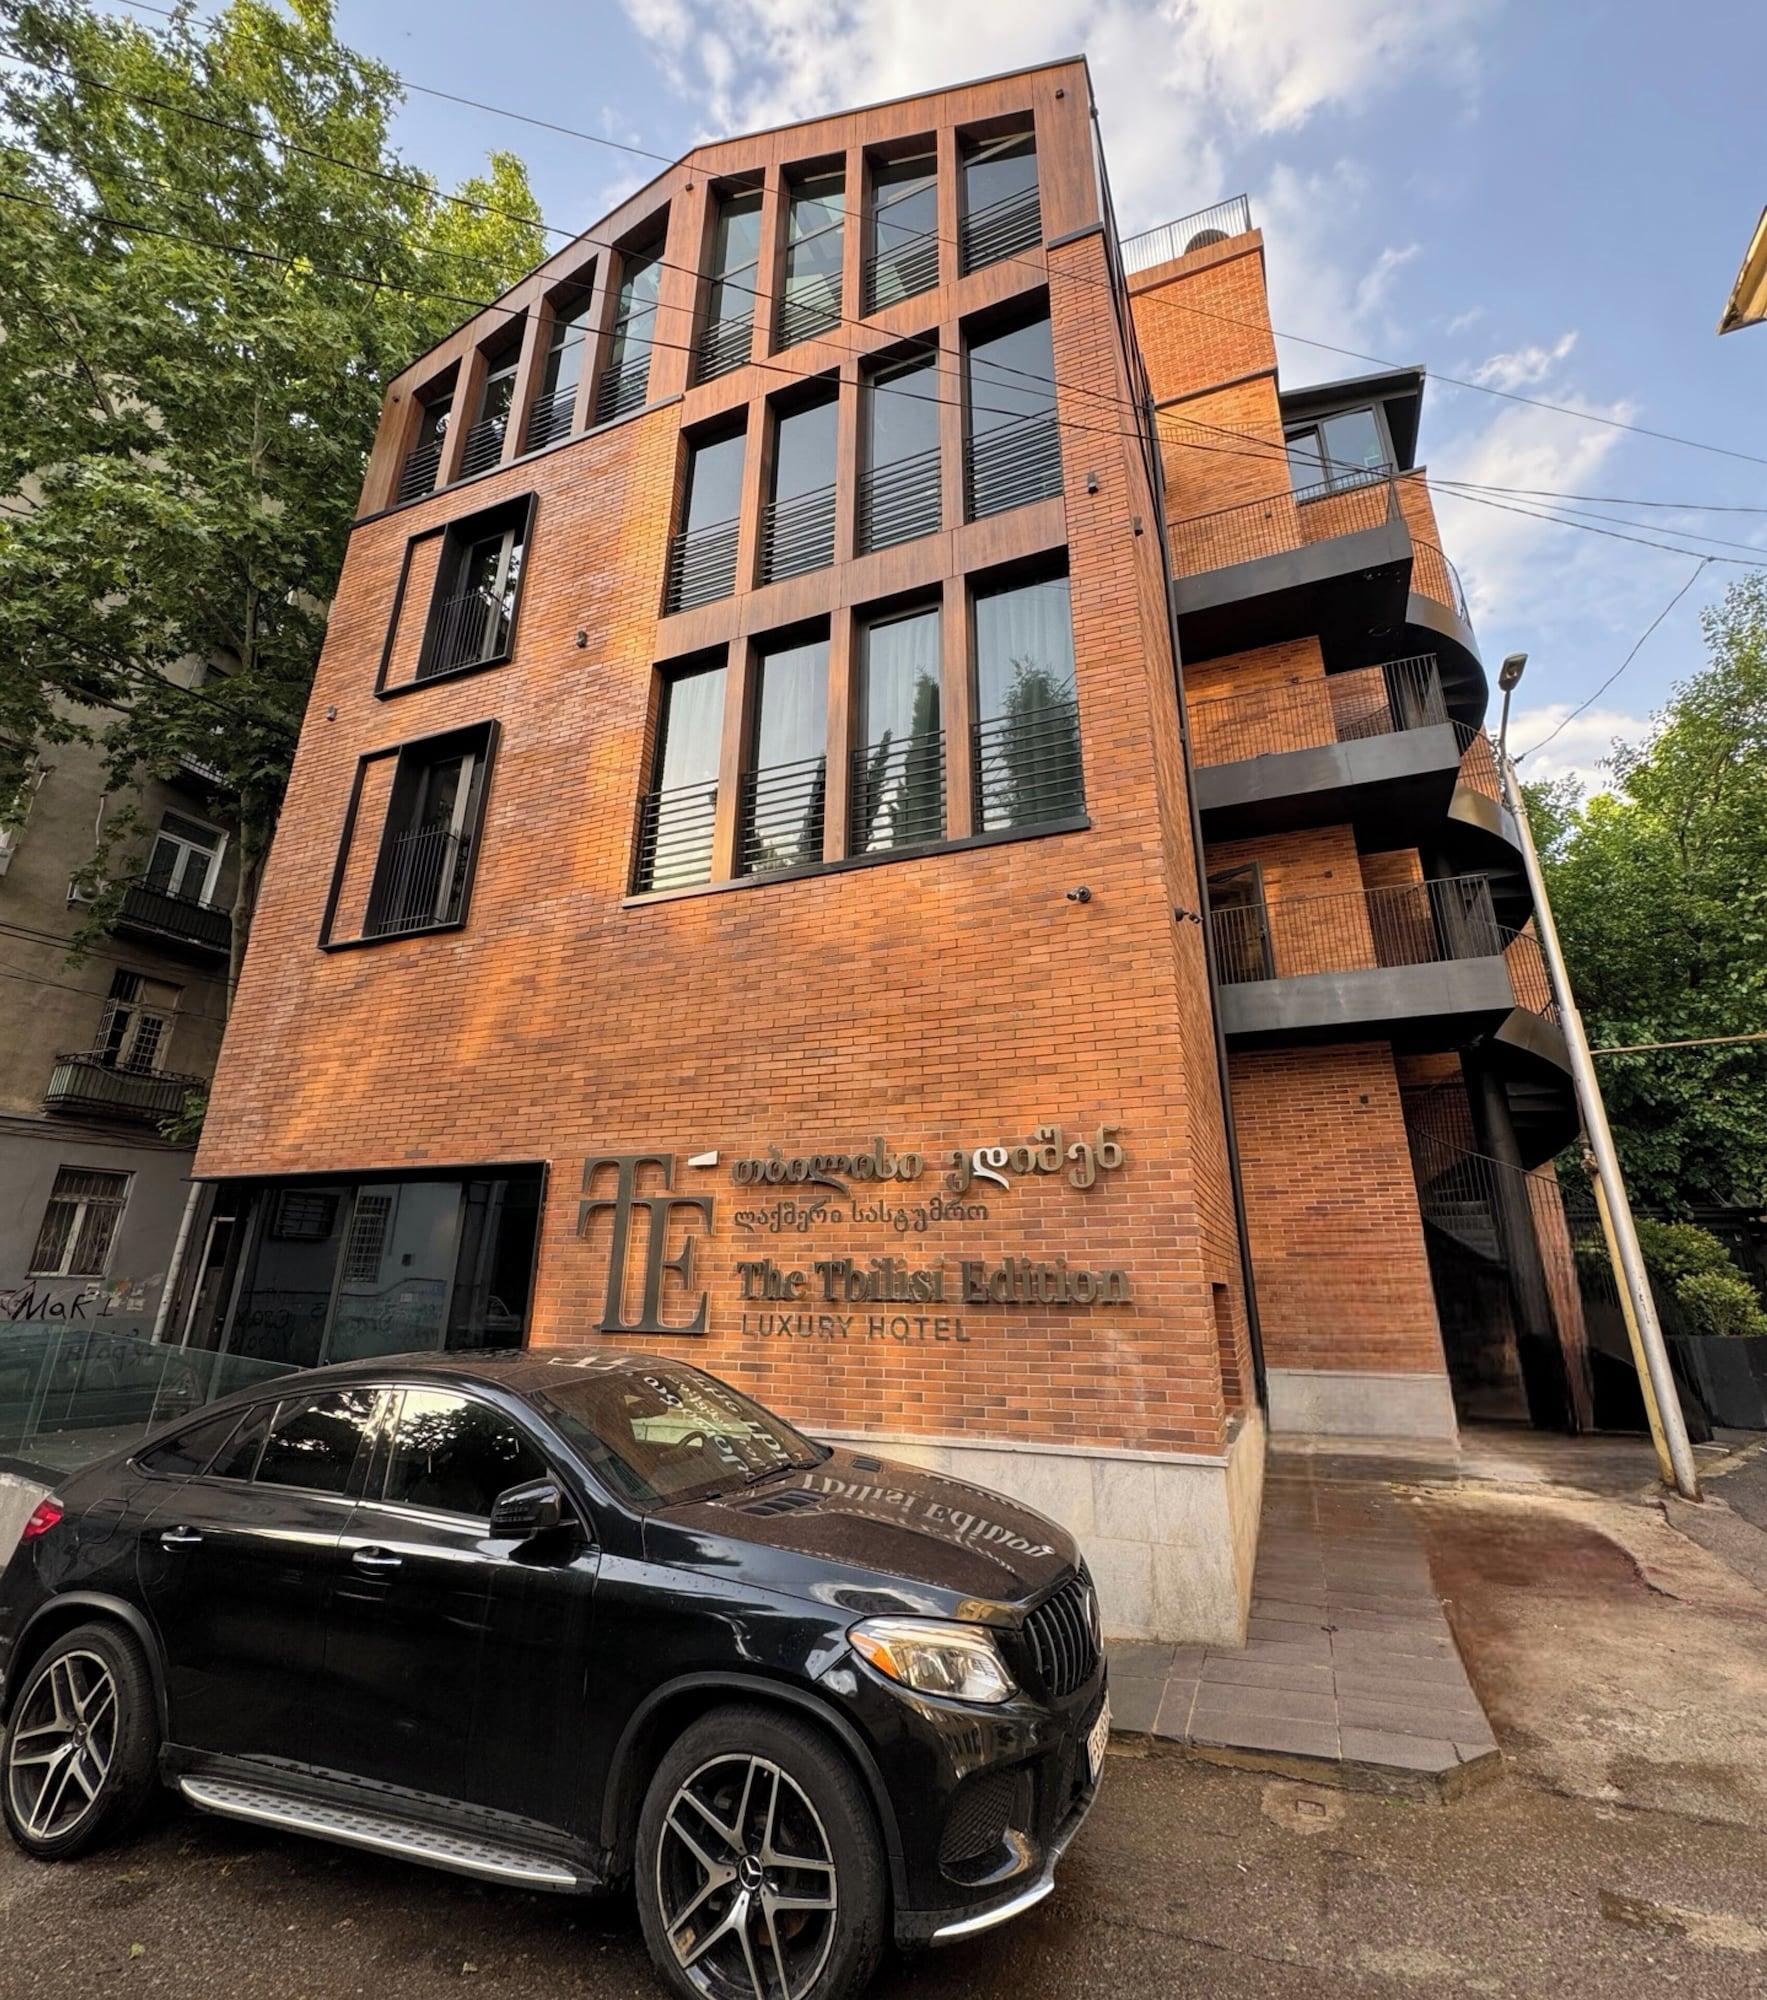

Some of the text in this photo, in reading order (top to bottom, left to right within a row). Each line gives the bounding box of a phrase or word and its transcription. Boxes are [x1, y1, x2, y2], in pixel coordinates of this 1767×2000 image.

[731, 1124, 1123, 1195] თბილისი ედიშენ
[734, 1196, 988, 1233] ლაქშერი სასტუმრო
[736, 1256, 1134, 1305] The Tbilisi Edition
[742, 1313, 971, 1342] LUXURY HOTEL
